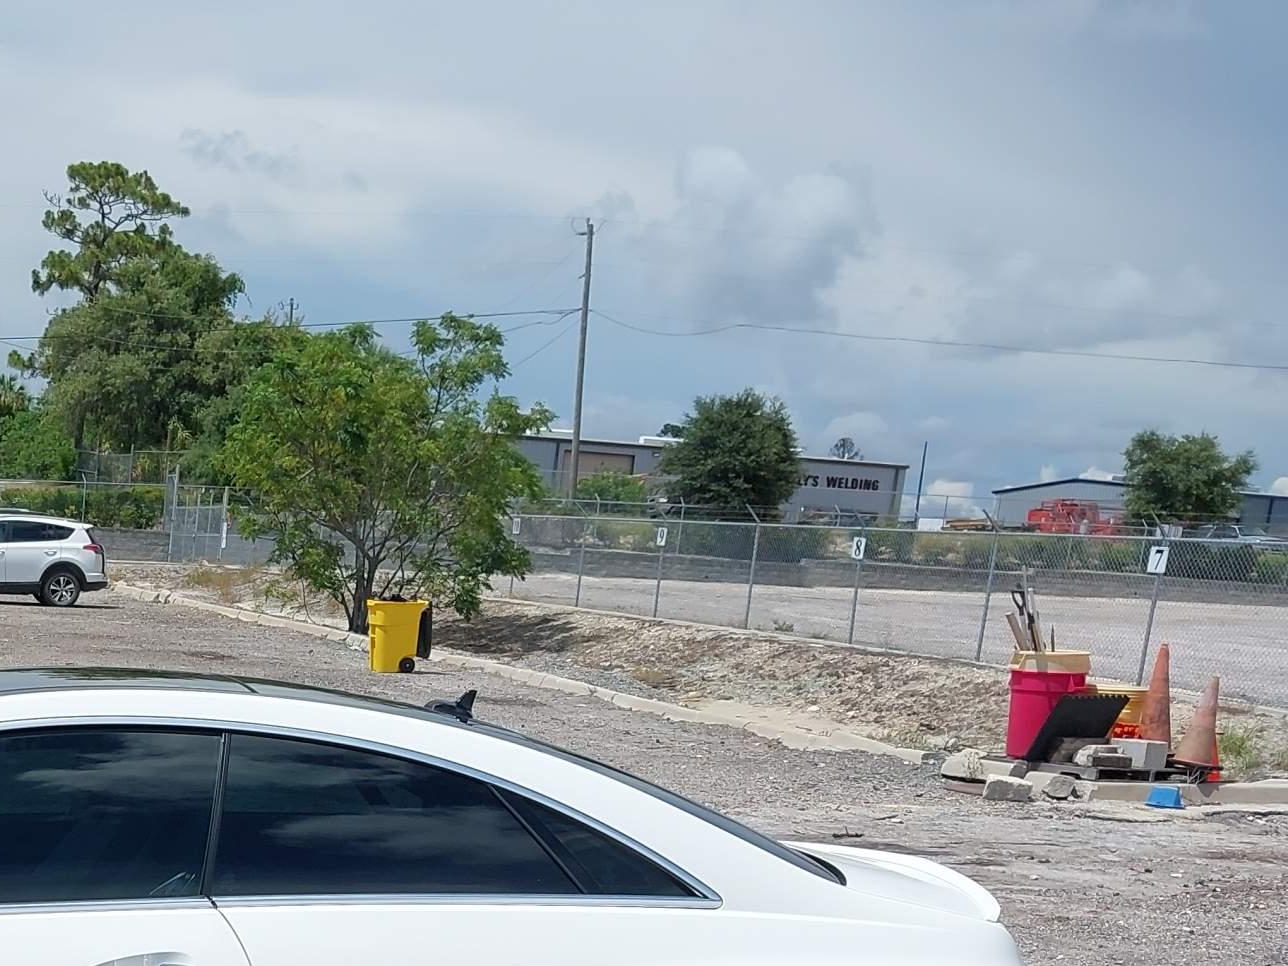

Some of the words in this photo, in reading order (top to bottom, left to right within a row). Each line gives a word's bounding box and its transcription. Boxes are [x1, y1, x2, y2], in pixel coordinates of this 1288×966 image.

[826, 476, 880, 491] WELDING
[658, 528, 665, 544] 9
[854, 539, 862, 557] 8
[1155, 549, 1165, 570] 7
